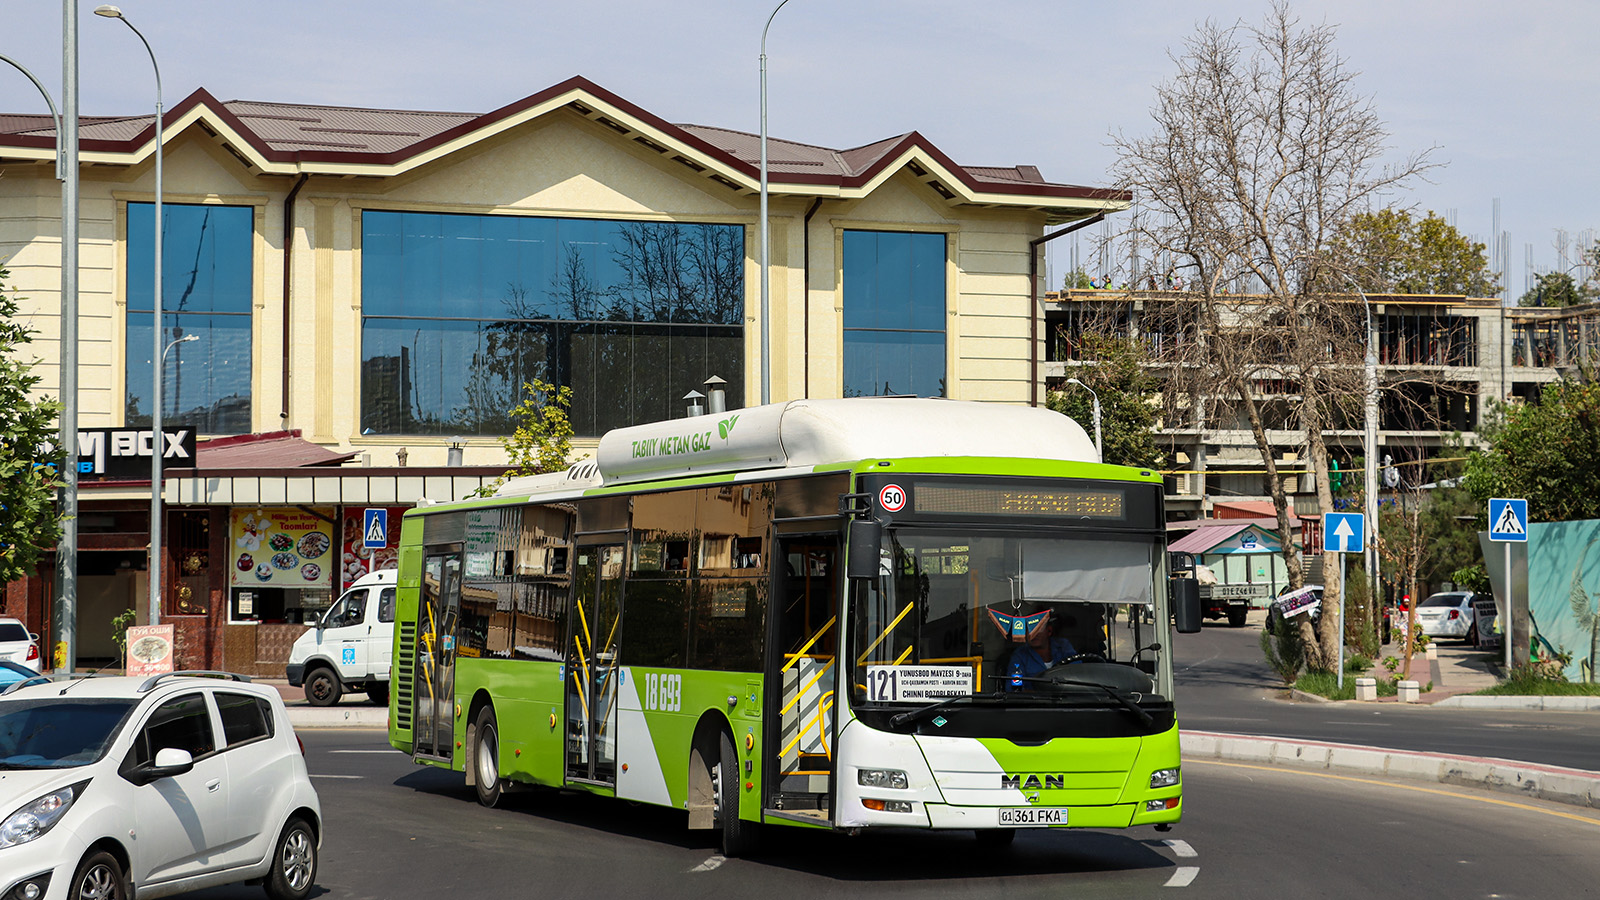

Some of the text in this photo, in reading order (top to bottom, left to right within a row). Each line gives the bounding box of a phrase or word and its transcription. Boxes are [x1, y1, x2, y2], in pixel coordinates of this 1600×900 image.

[111, 430, 190, 458] BOX
[631, 431, 712, 459] TABIIY METAN GAZ
[884, 491, 902, 505] 50
[279, 522, 318, 530] Taomlari
[149, 626, 170, 635] ОШИ
[930, 669, 954, 678] MAVZESI
[867, 669, 897, 700] 121
[902, 690, 924, 698] CHINNI
[1001, 774, 1064, 790] MAN
[1001, 810, 1061, 823] 01 361 FKA
